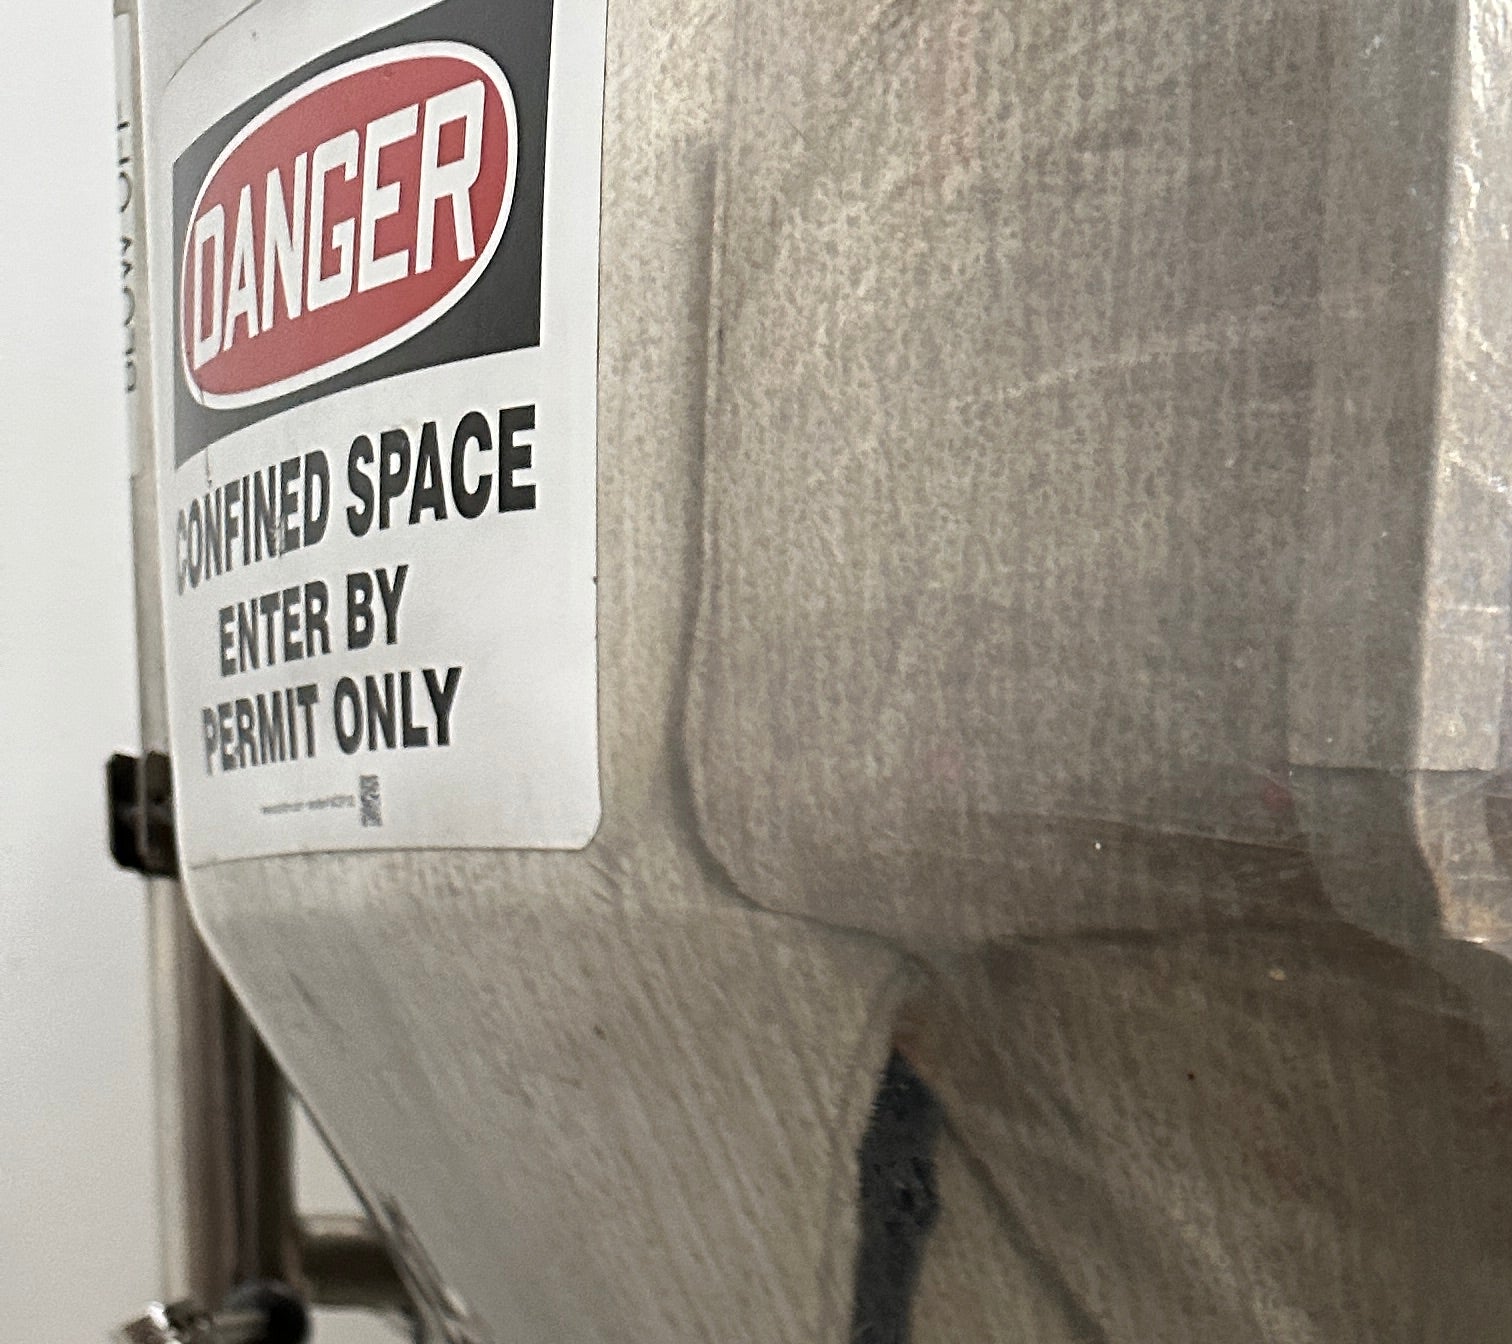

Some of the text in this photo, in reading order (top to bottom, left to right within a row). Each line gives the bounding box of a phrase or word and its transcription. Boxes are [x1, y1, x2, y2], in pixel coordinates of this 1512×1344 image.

[192, 79, 487, 371] DANGER
[175, 404, 537, 596] CONFINED SPACE
[219, 564, 409, 677] ENTER BY
[202, 666, 463, 776] PERMIT ONLY
